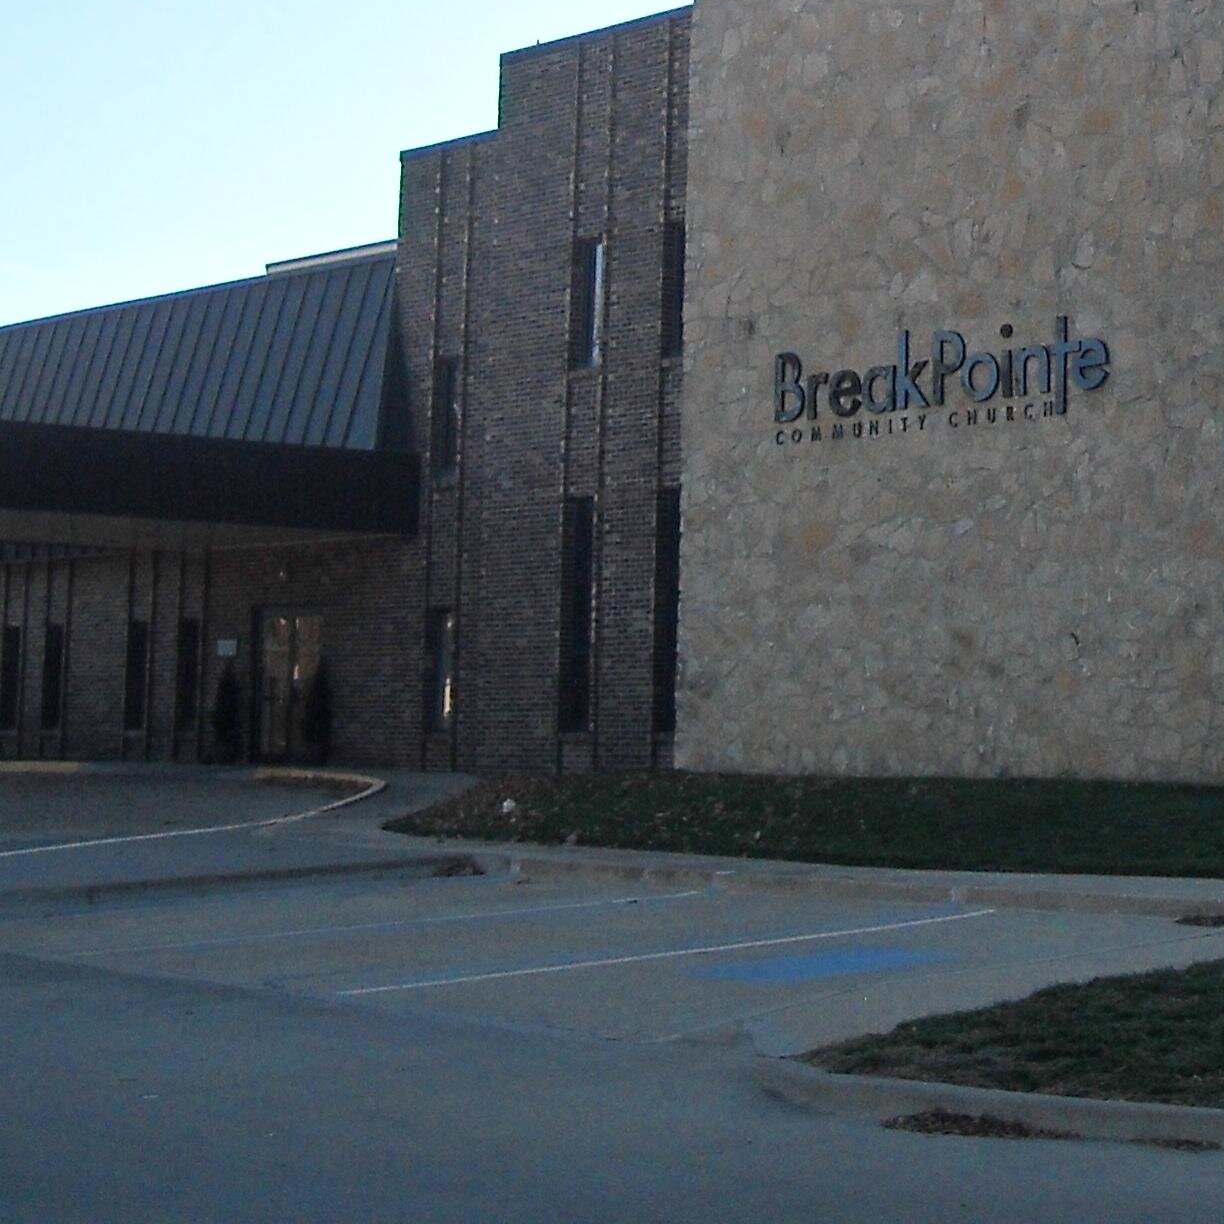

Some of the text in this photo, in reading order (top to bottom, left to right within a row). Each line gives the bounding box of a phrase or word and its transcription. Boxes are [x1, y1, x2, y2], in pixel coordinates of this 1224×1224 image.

[774, 315, 1111, 423] BreakPointe
[775, 400, 1054, 445] COMMUNITY CHURCH
